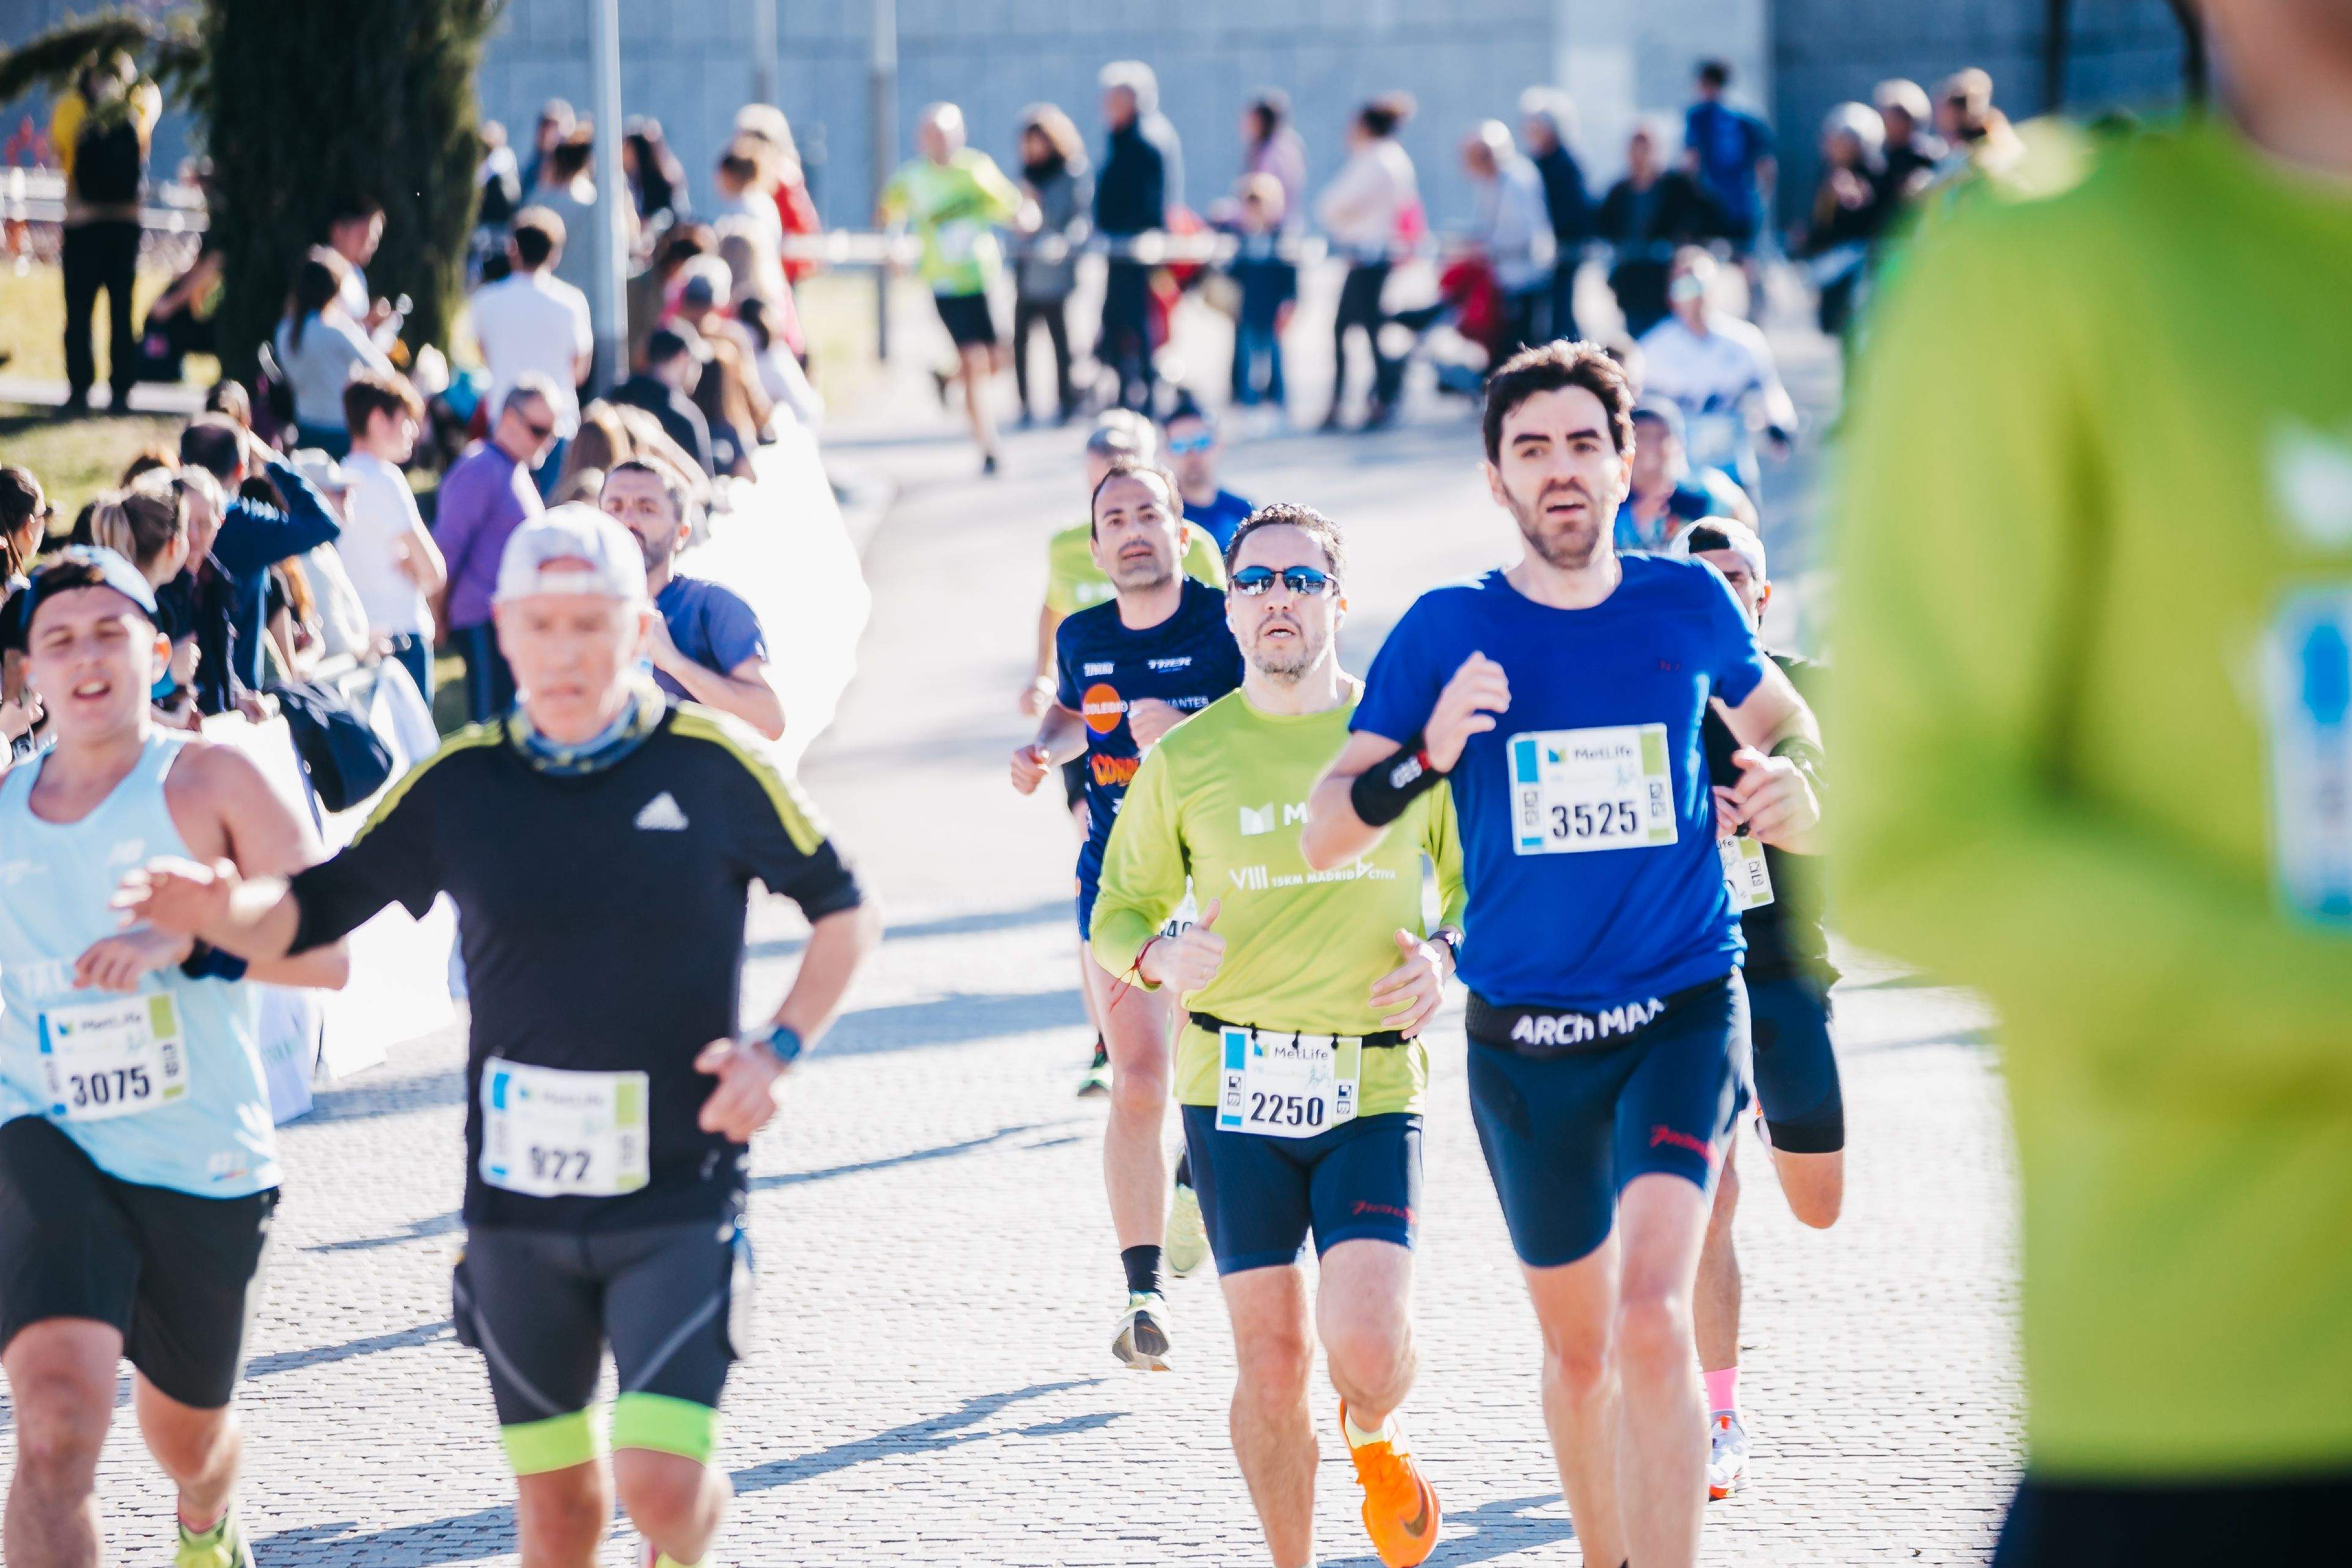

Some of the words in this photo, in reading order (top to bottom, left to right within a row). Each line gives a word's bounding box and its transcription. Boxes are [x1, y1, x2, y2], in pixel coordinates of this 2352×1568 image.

[1552, 800, 1636, 839] 3525
[1229, 864, 1269, 891] VIII
[1306, 870, 1355, 885] MADRID
[1275, 1046, 1328, 1060] MetLife
[70, 1065, 150, 1107] 3075
[1250, 1092, 1324, 1127] 2250
